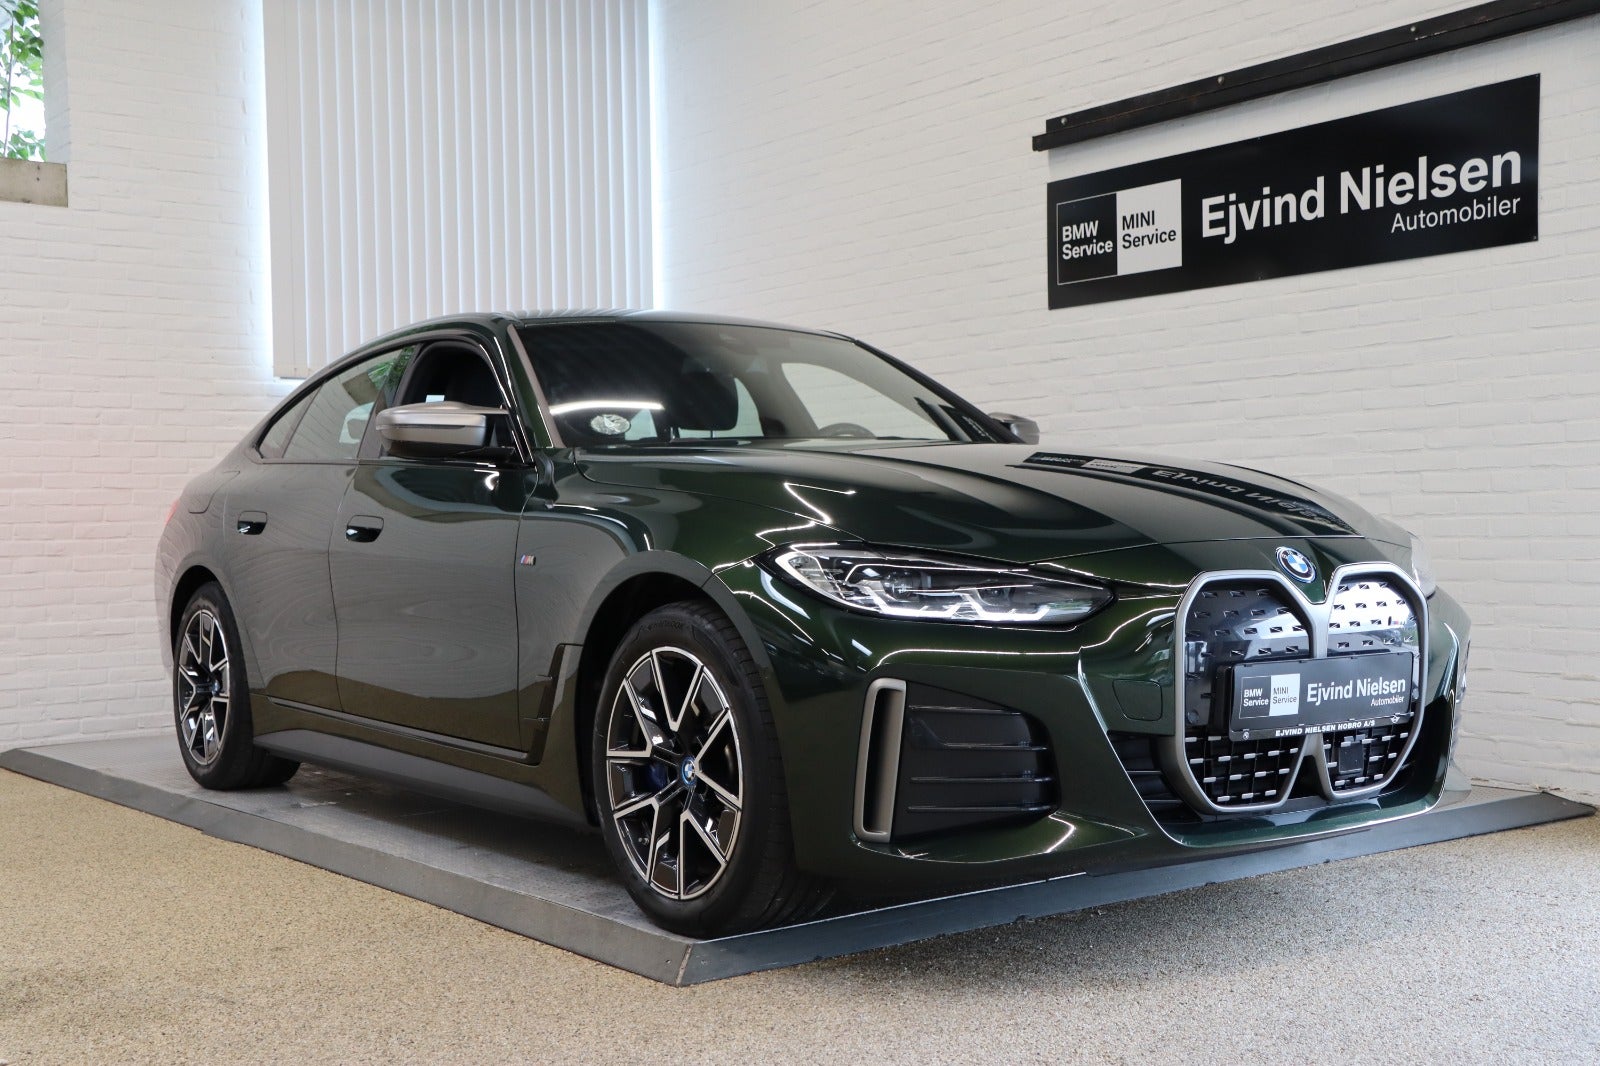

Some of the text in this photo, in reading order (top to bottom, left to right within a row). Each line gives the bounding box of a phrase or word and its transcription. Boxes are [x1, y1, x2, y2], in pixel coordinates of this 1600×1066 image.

[1202, 150, 1522, 245] Ejvind Nielsen
[1122, 210, 1155, 231] MINI
[1391, 197, 1521, 234] Automobiler
[1062, 220, 1099, 243] BMW
[1122, 226, 1177, 250] Service
[1062, 237, 1113, 261] Service
[1243, 687, 1263, 698] BMW
[1272, 696, 1298, 704] Service
[1273, 686, 1289, 695] MINI
[1307, 676, 1406, 706] Ejvind Nielsen
[1370, 694, 1405, 707] Automobiler
[1243, 697, 1269, 707] Service
[1275, 719, 1376, 737] EJVIND NIELSEN HOBRO A/S
